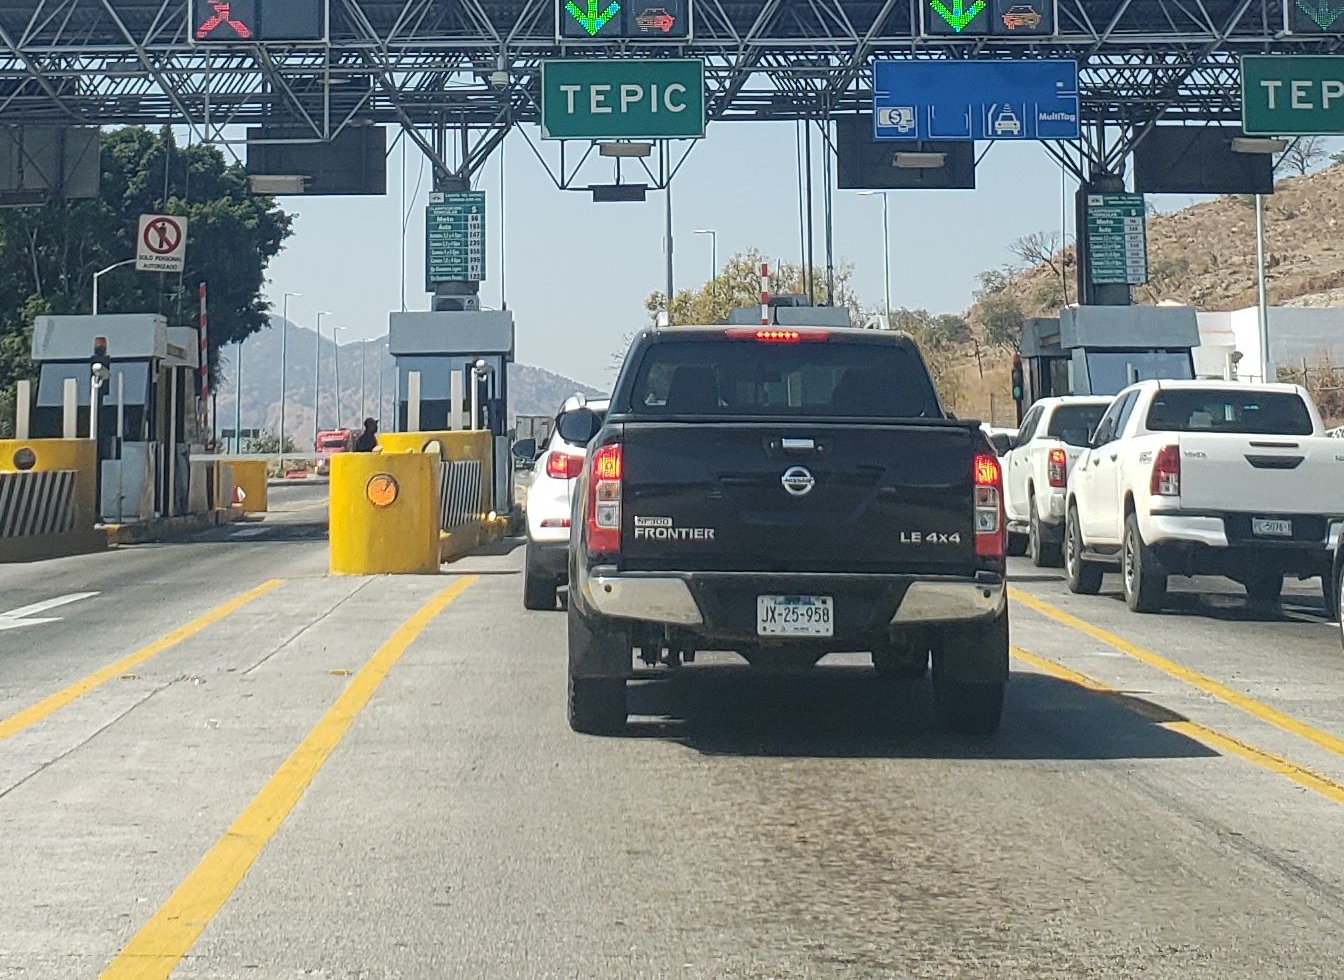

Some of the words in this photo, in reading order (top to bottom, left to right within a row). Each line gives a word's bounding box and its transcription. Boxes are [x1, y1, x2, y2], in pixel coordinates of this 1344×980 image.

[559, 82, 687, 115] TEPIC
[1038, 111, 1086, 123] MultiTag
[634, 526, 716, 540] FRONTIER
[900, 531, 922, 543] LE
[925, 531, 961, 544] 4x4
[760, 605, 831, 624] JX-25-958
